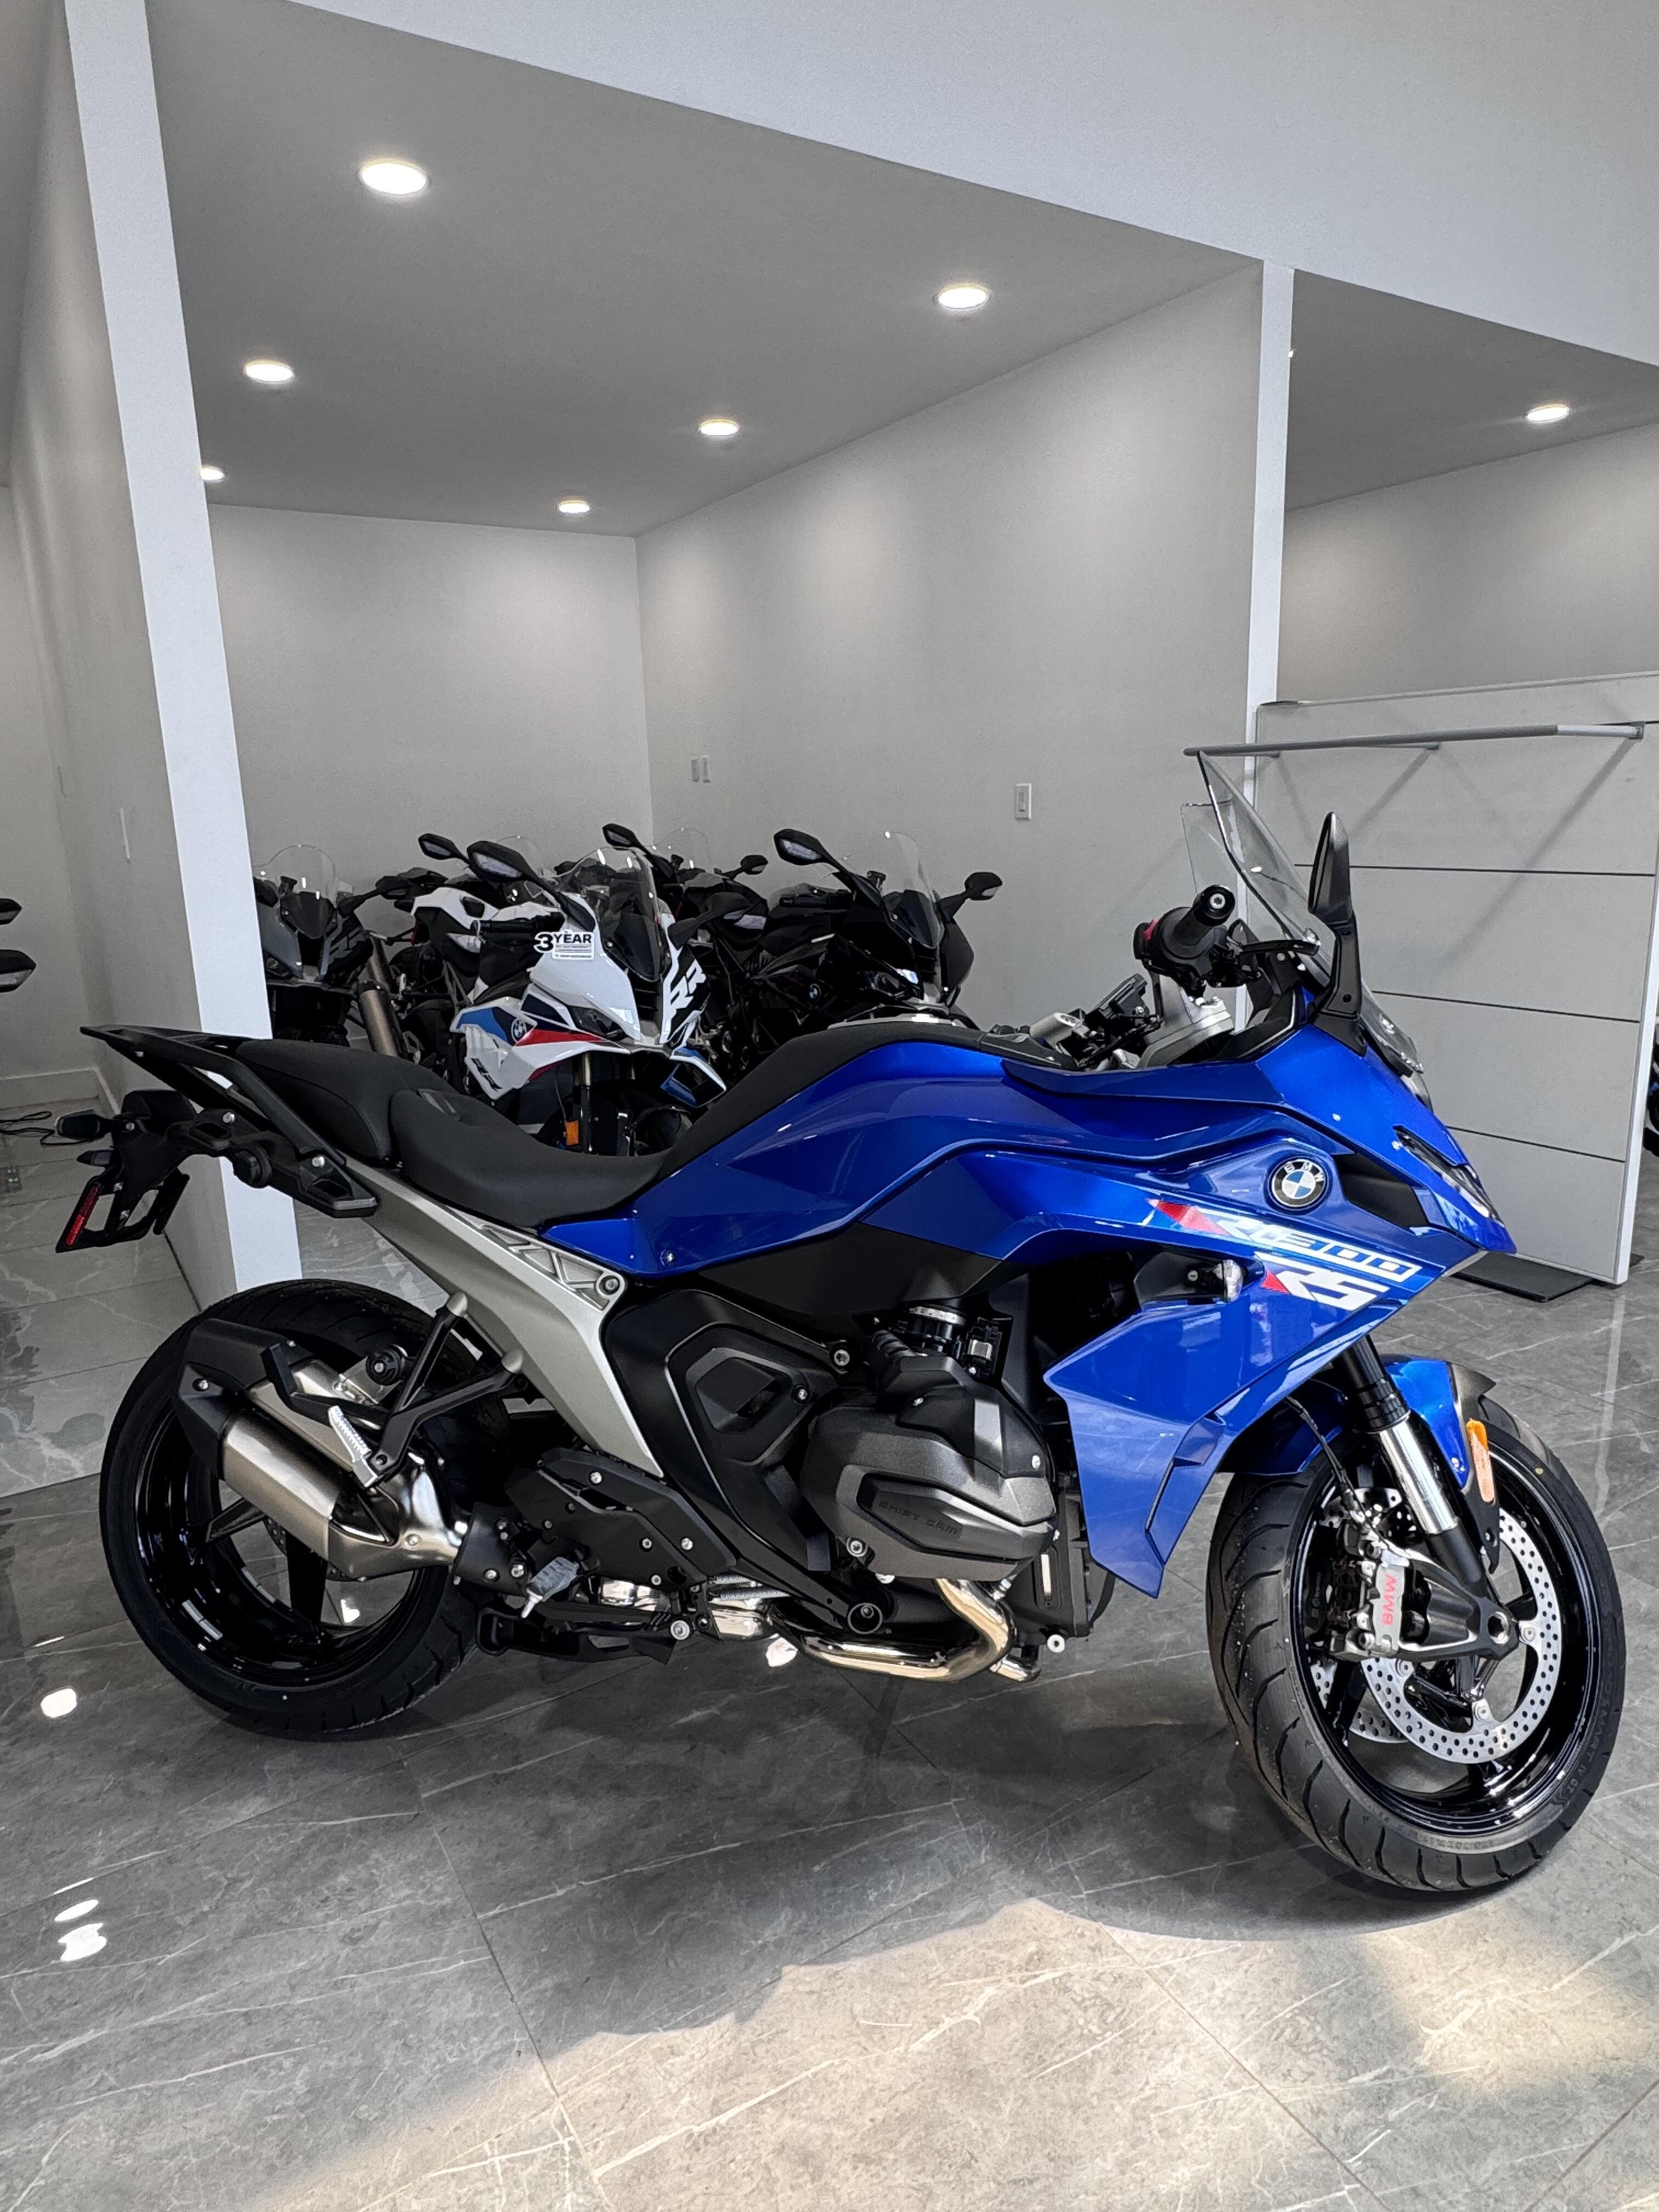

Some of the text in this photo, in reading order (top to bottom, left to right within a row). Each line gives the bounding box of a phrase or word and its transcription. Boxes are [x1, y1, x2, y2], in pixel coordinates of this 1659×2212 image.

[537, 934, 592, 951] 3 YEAR
[1254, 1251, 1390, 1311] RS
[1381, 1572, 1397, 1626] BMW
